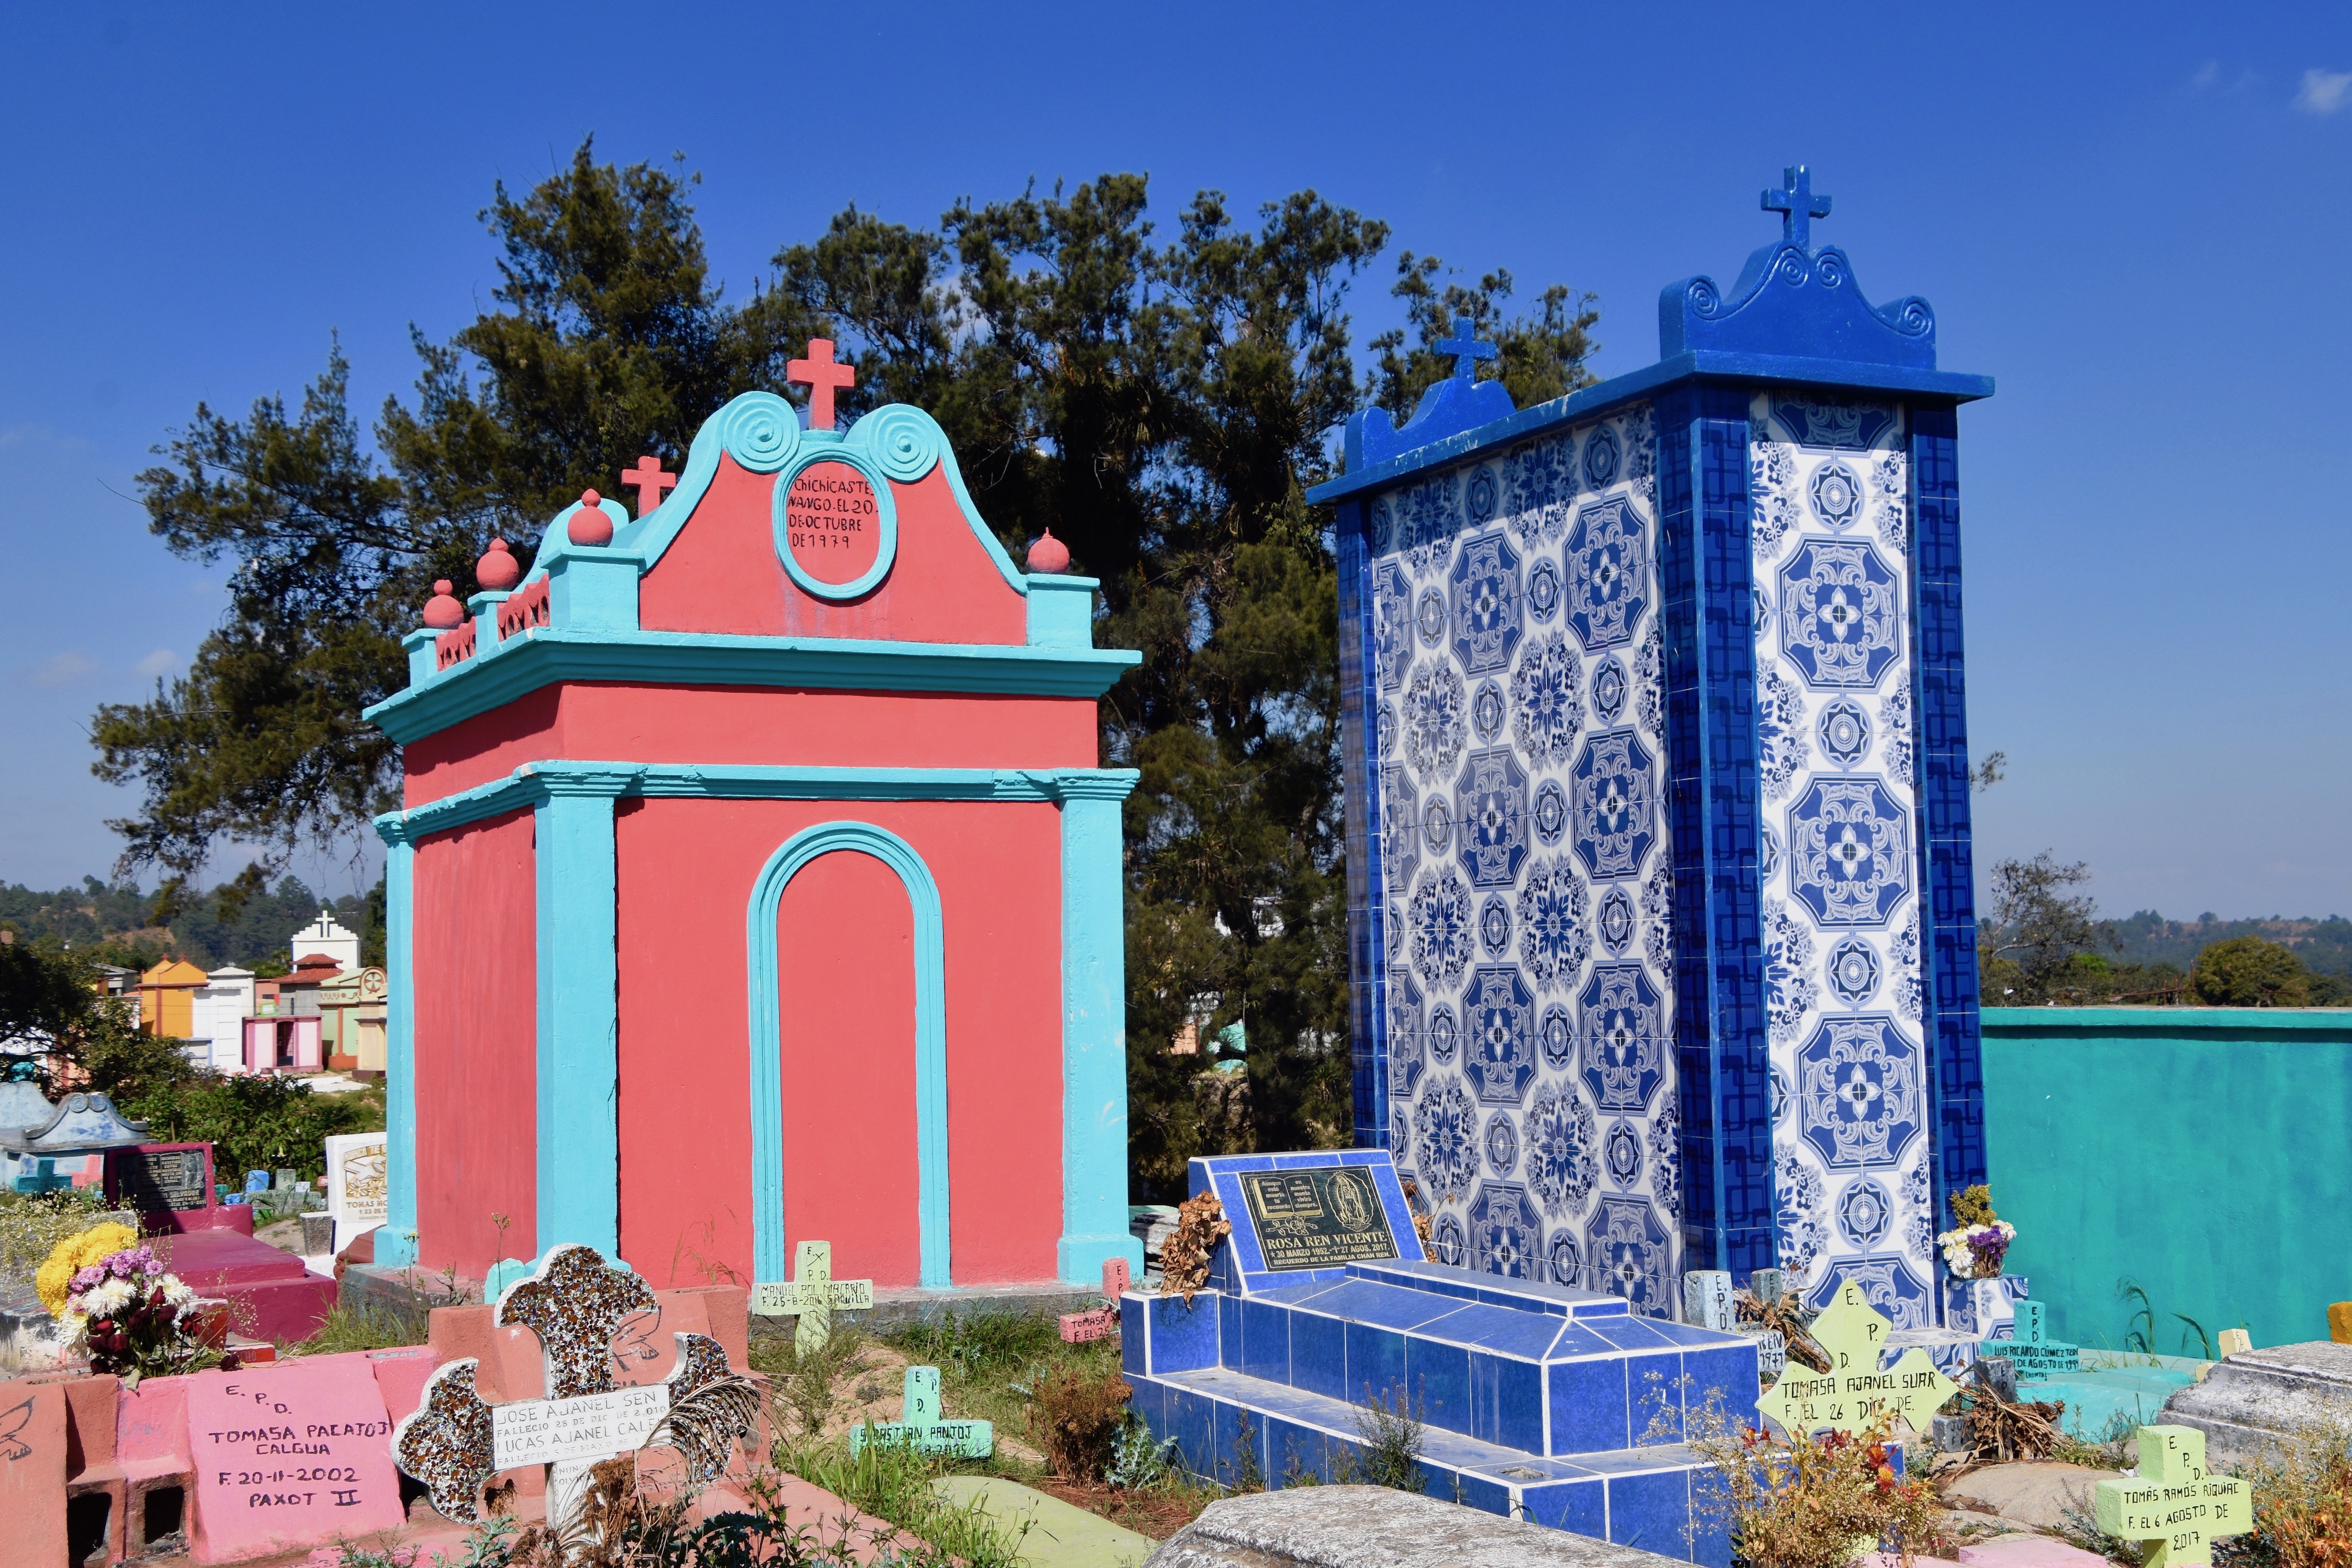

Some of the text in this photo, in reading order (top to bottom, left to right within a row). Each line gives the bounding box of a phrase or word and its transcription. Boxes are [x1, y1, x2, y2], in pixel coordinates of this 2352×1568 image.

[837, 499, 849, 512] EL
[792, 533, 849, 549] DE 1979
[1265, 1232, 1387, 1249] ROSA REN VICENTE
[807, 1246, 815, 1256] E.
[1287, 1248, 1310, 1257] MARZO
[1350, 1244, 1371, 1253] AGOS.
[1372, 1243, 1390, 1251] 2017.
[1274, 1257, 1309, 1265] RECUERDO
[761, 1284, 795, 1296] MANUEL
[801, 1285, 818, 1296] POL
[1846, 1288, 1859, 1305] E.
[763, 1297, 769, 1306] F.
[1071, 1316, 1105, 1329] TOMASA
[1074, 1331, 1081, 1342] F.
[1085, 1329, 1094, 1338] EL
[1866, 1323, 1878, 1341] P.
[1994, 1345, 2007, 1356] LUIS
[2009, 1345, 2039, 1357] RICARDO
[1840, 1352, 1850, 1369] D.
[2017, 1359, 2026, 1368] DE
[2028, 1359, 2056, 1369] AGOSTO
[2058, 1360, 2063, 1369] DE
[226, 1385, 245, 1396] E.
[1781, 1378, 1836, 1399] TOMASA
[1847, 1375, 1897, 1393] AJANEL
[255, 1393, 269, 1406] P.
[274, 1403, 292, 1414] D.
[497, 1392, 656, 1425] JOSE AJANEL SEN
[1785, 1404, 1797, 1420] F.
[1804, 1403, 1819, 1419] EL
[1830, 1403, 1843, 1420] 26
[208, 1426, 296, 1443] TOMASA
[497, 1435, 544, 1453] LUCAS
[552, 1426, 611, 1444] AJANEL
[256, 1443, 330, 1455] CALGUA
[580, 1442, 612, 1453] MAYO
[2183, 1452, 2190, 1467] P.
[219, 1467, 362, 1485] F. 20-11-2002
[559, 1464, 590, 1475] NUNCA
[2193, 1467, 2204, 1480] D.
[249, 1489, 362, 1507] PAXOT II
[2124, 1486, 2159, 1504] TOMÁS
[2129, 1504, 2229, 1529] F. EL 6 AGOSTO DE
